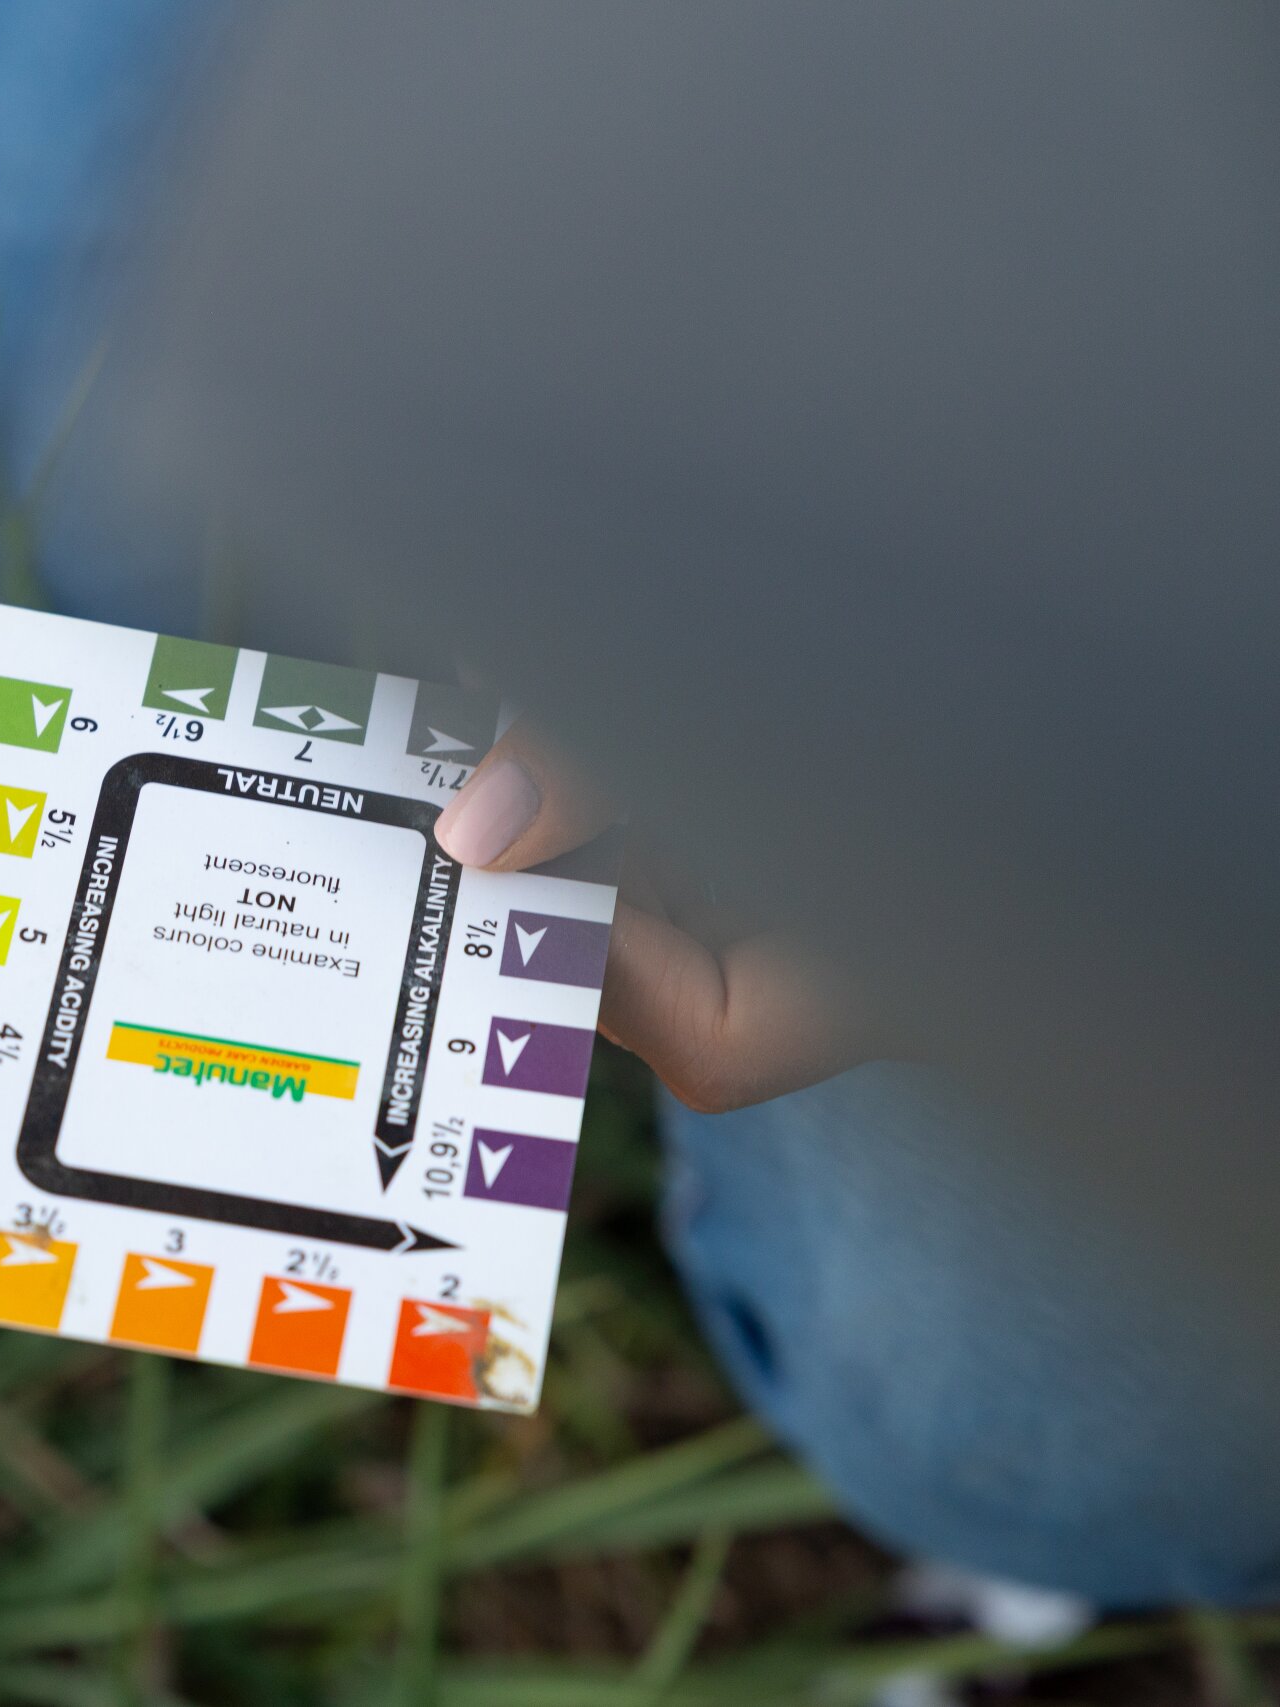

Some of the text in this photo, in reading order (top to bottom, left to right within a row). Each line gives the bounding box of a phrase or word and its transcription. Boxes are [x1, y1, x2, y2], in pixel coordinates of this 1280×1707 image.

[70, 716, 98, 734] 6
[295, 740, 314, 762] 7
[217, 768, 364, 814] NEUTRAL
[204, 855, 341, 893] fluorescent
[237, 888, 296, 912] NOT
[19, 927, 47, 945] 5
[174, 902, 350, 948] in natural light
[46, 834, 119, 1071] INCREASING ACIDITY
[153, 927, 360, 978] Examine colours
[386, 853, 453, 1126] INCREASING ALKALINITY
[158, 1038, 311, 1072] GARDEN CARE PRODUCTS
[448, 1038, 476, 1055] 9
[153, 1055, 307, 1102] Manutec
[166, 1230, 185, 1253] 3
[439, 1275, 461, 1300] 2
